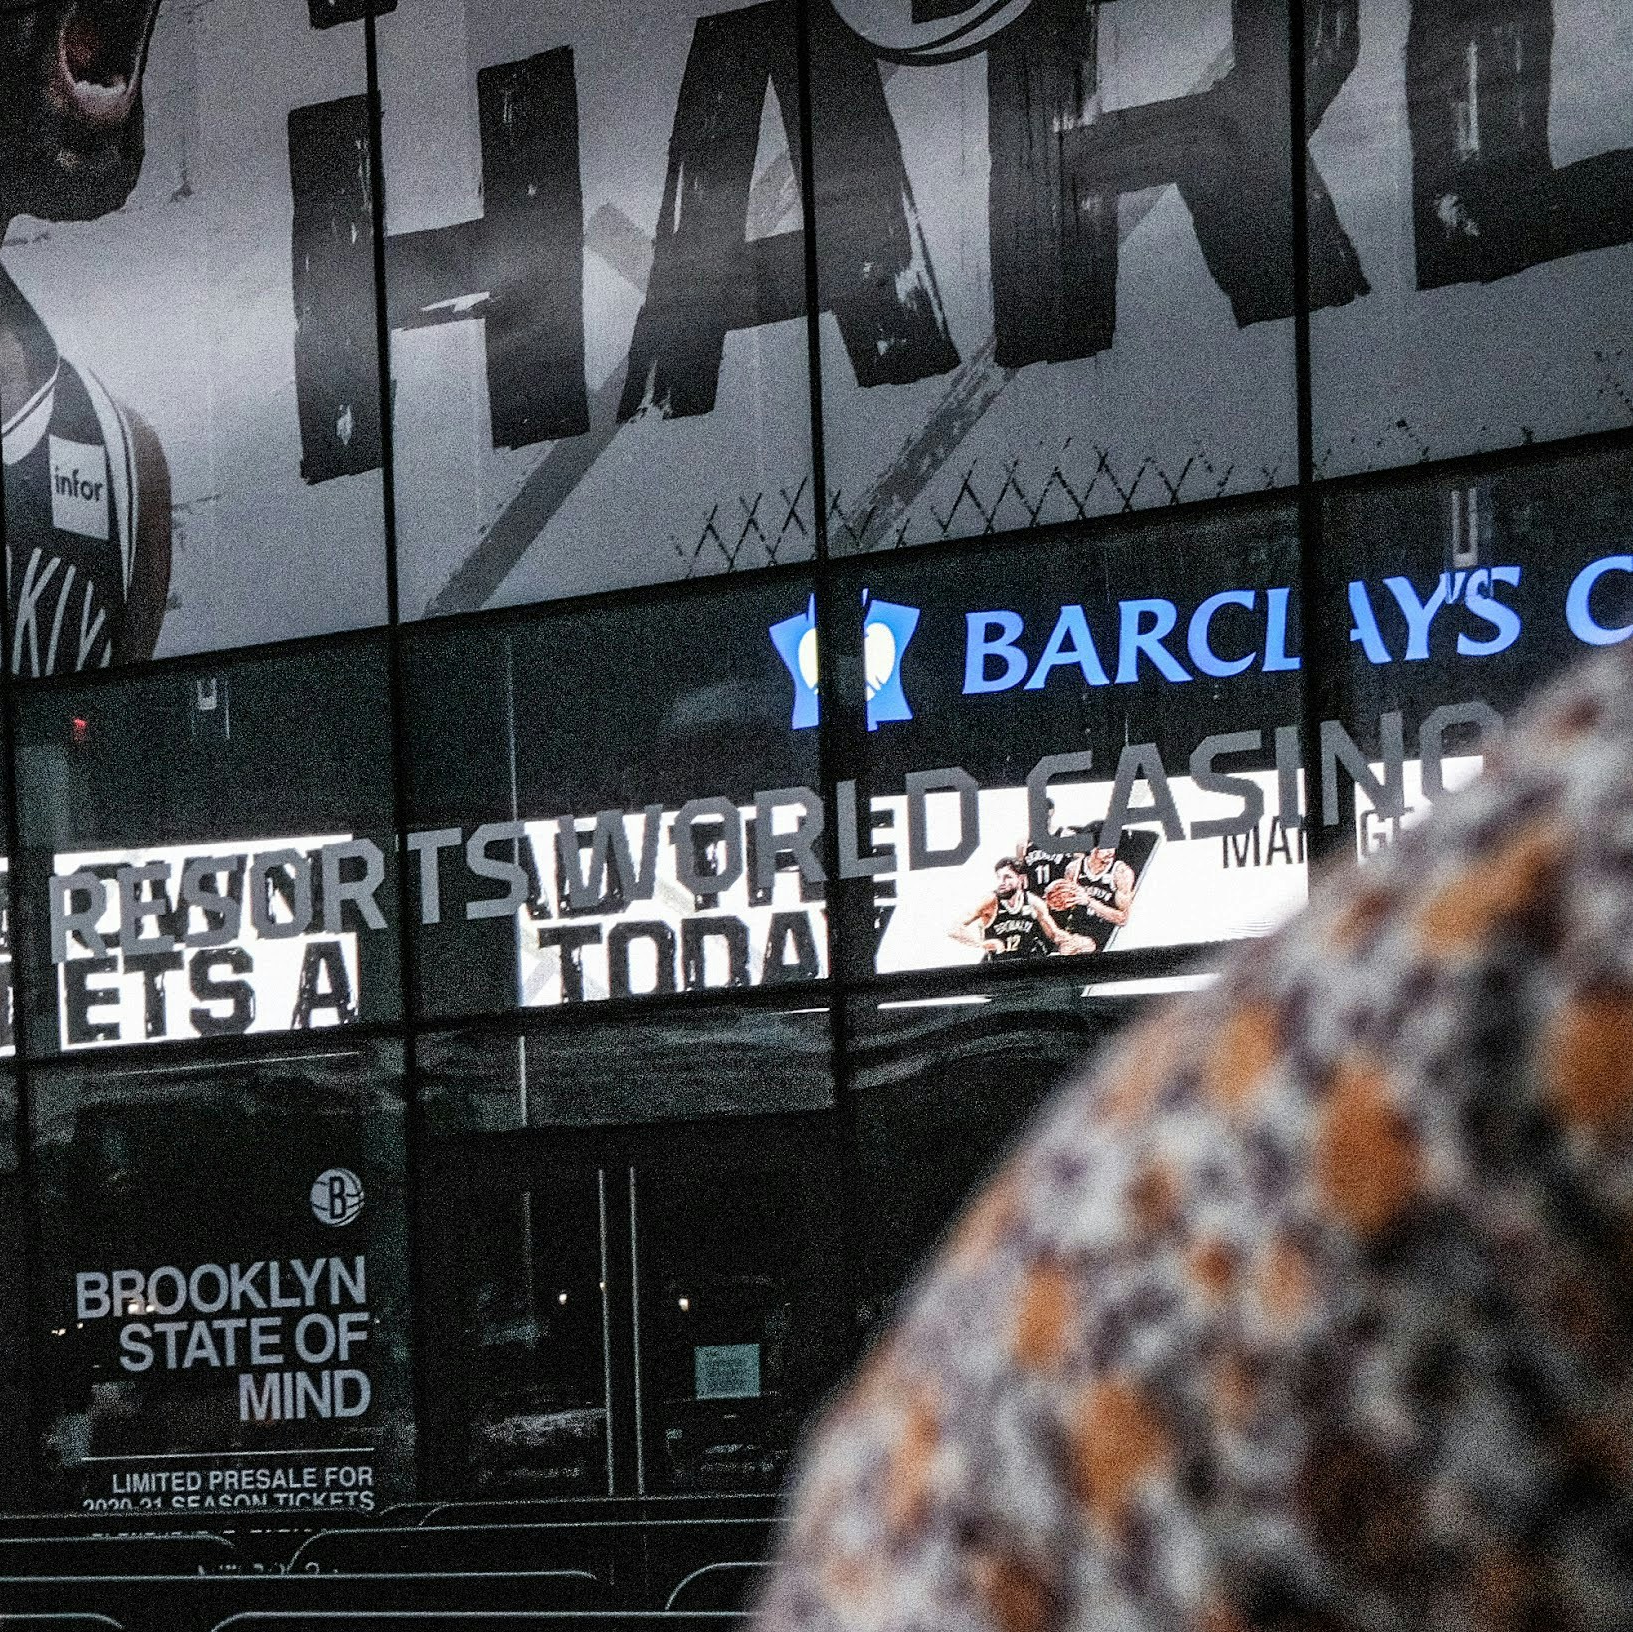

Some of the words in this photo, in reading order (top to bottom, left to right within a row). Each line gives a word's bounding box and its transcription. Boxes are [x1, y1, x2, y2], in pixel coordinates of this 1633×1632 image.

[54, 465, 104, 502] infor
[962, 565, 1521, 696] BARCLAYS
[75, 1255, 367, 1320] BROOKLYN
[119, 1318, 285, 1373] STATE
[294, 1312, 371, 1366] OF
[239, 1369, 372, 1422] MIND
[111, 1471, 203, 1494] LIMITED
[208, 1467, 318, 1491] PRESALE
[324, 1465, 375, 1487] FOR
[170, 1493, 268, 1508] SEASON
[273, 1490, 376, 1511] TICKETS
